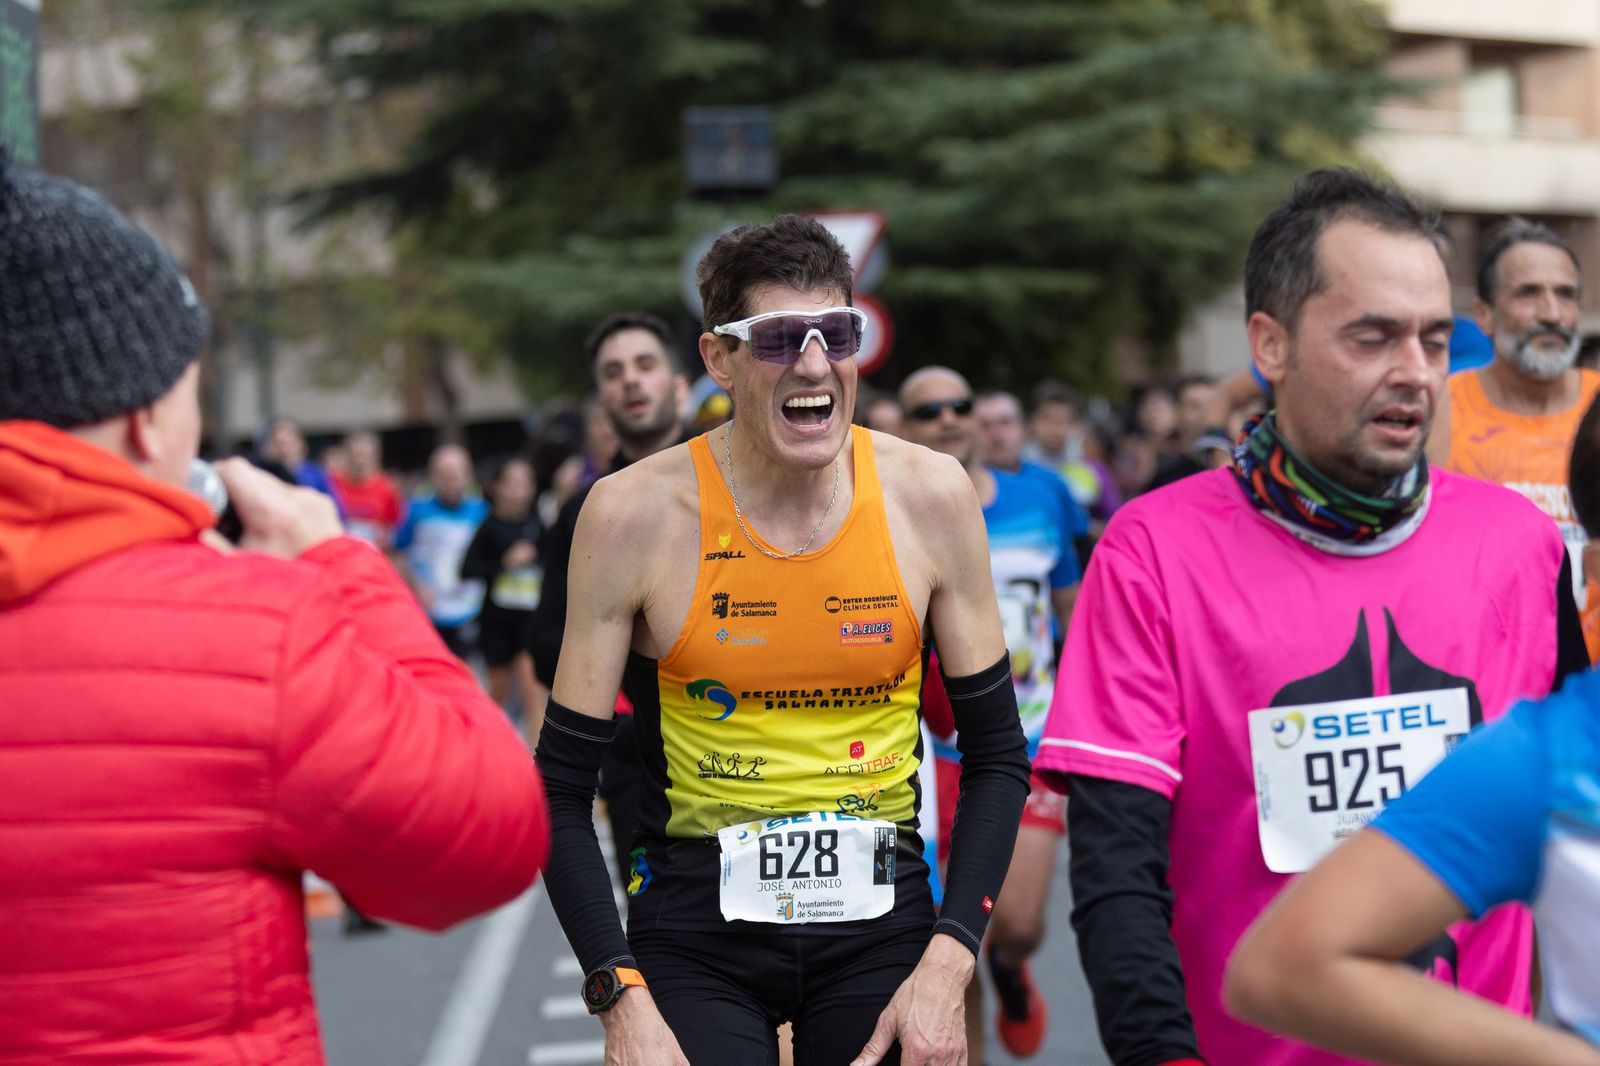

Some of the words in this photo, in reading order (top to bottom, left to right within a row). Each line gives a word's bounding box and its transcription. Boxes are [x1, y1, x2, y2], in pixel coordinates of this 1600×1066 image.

[704, 551, 746, 561] SPALL
[731, 600, 777, 609] Ayuntamiento
[741, 609, 777, 617] Salamanca
[741, 689, 824, 699] ESCUELA
[1312, 703, 1446, 739] SETEL
[824, 752, 899, 774] ACCITRAF
[1305, 743, 1406, 813] 925
[759, 829, 839, 880] 628
[757, 880, 785, 892] JOSÉ
[791, 879, 842, 890] ANTONIO
[797, 900, 844, 909] Ayuntamiento
[807, 909, 844, 917] Salamanca
